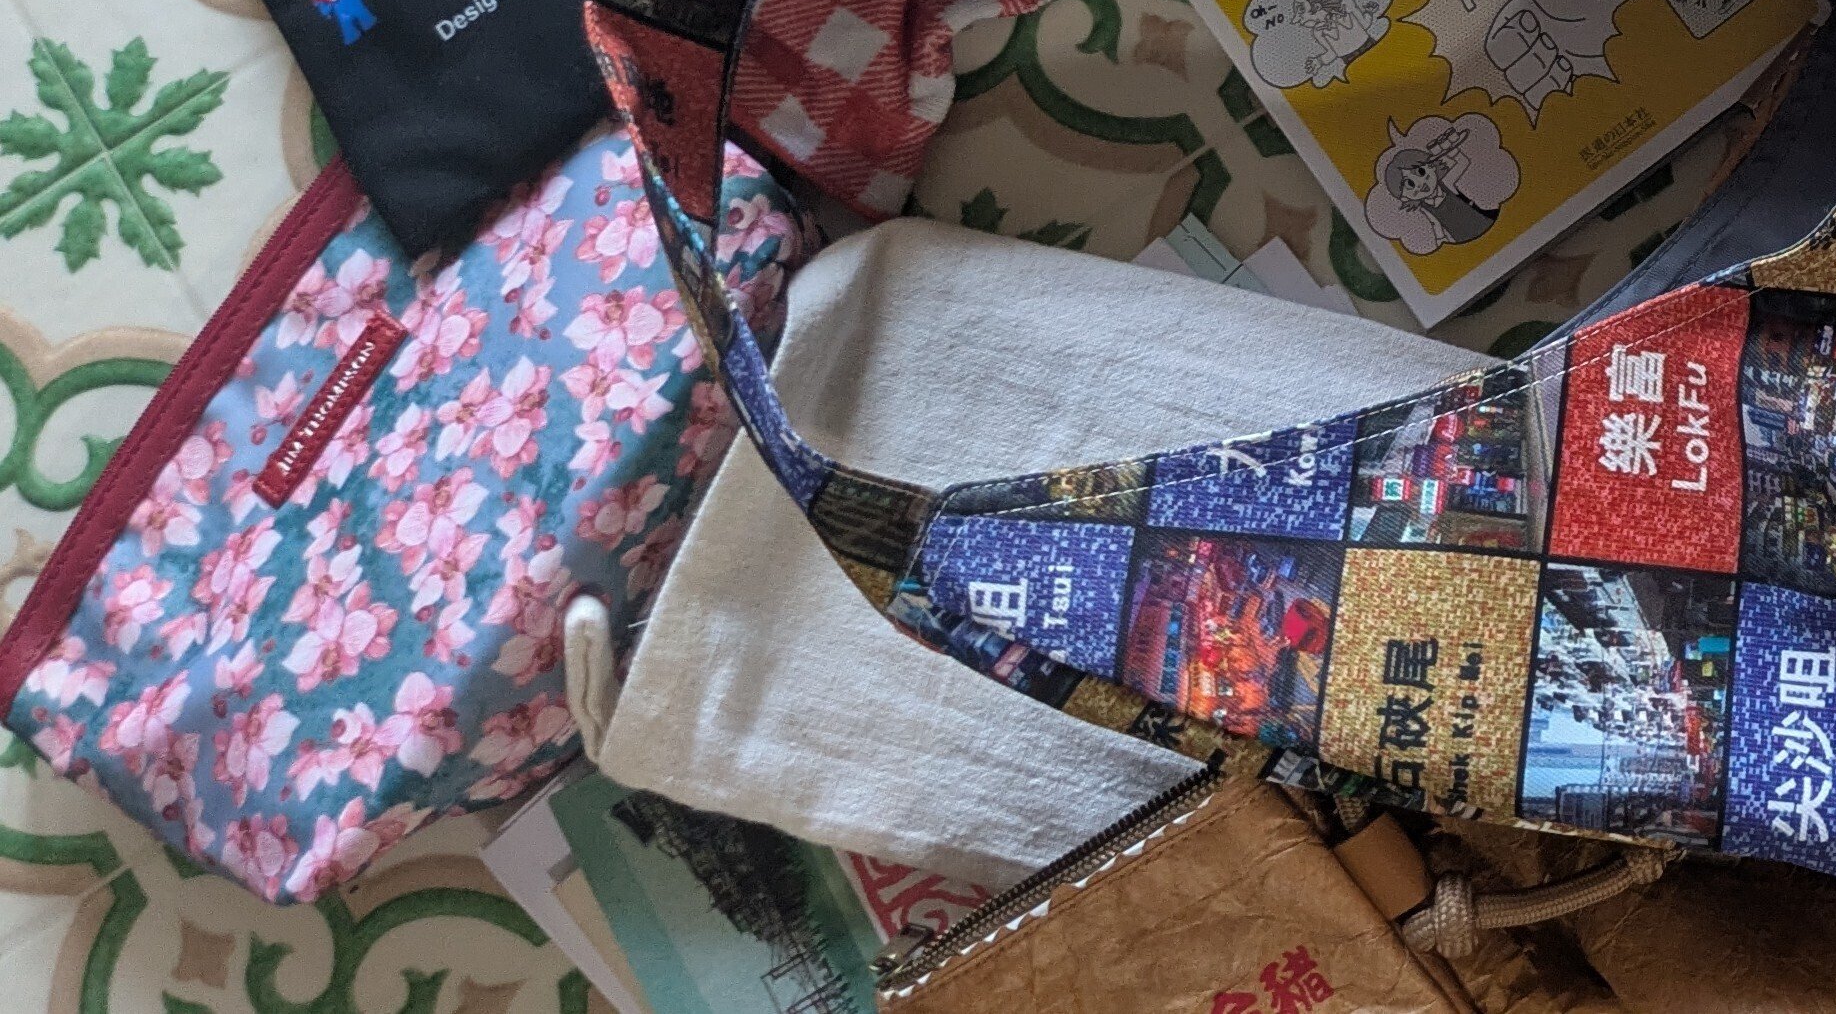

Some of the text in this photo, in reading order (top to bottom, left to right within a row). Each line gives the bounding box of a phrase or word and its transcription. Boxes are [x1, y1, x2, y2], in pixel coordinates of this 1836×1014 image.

[278, 340, 377, 477] JIM THOMPSON
[1597, 343, 1668, 477] 樂富
[1671, 362, 1709, 494] LokFu
[1042, 555, 1075, 629] Tsui
[1458, 642, 1484, 681] Mei
[1452, 695, 1480, 738] Kip
